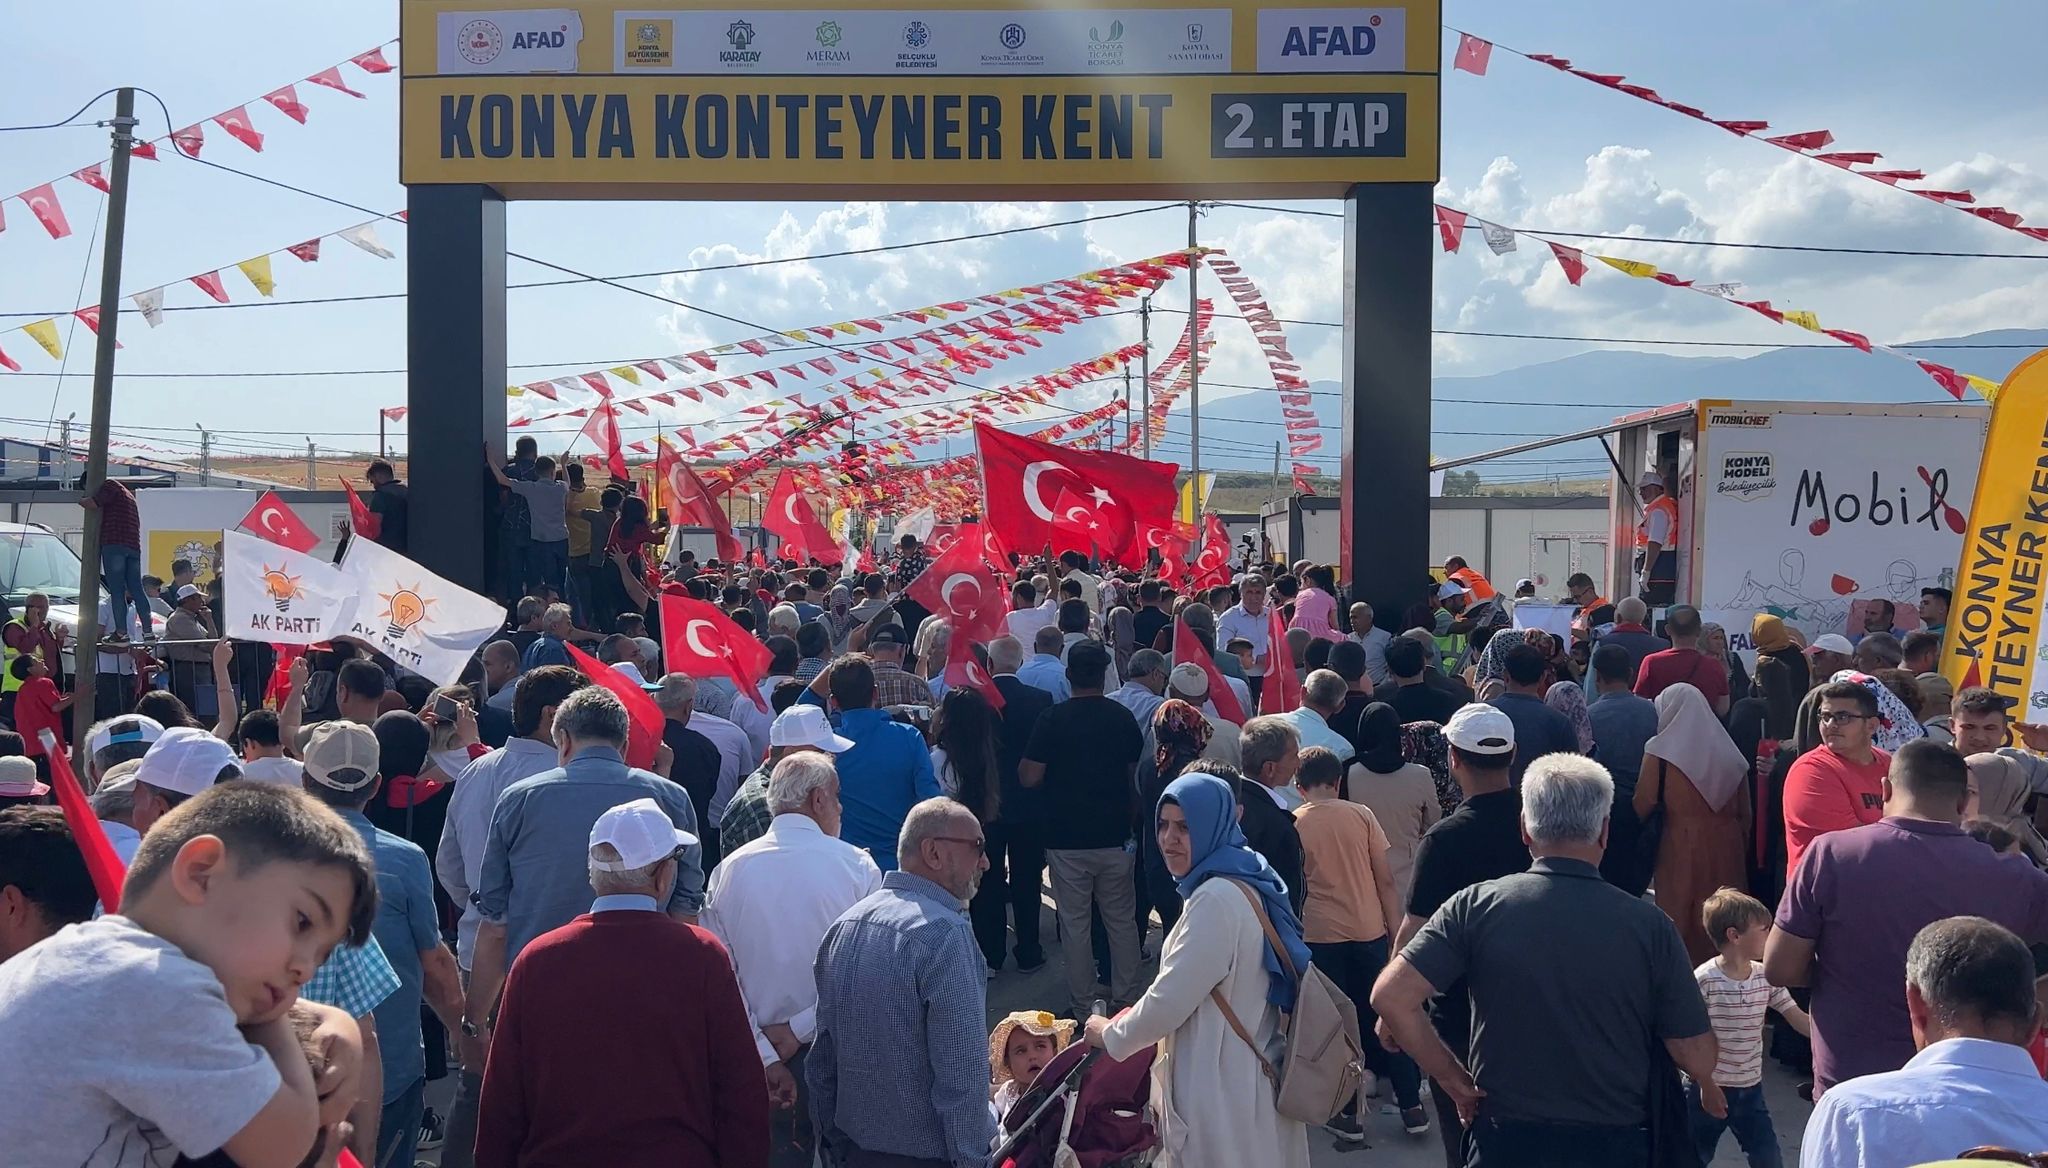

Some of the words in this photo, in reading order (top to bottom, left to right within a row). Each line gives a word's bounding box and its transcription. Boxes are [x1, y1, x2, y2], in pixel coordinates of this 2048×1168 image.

[512, 32, 565, 49] AFAD
[1281, 26, 1377, 57] AFAD
[719, 51, 762, 62] KARATAY
[806, 50, 851, 61] MERAM
[897, 53, 936, 61] SELÇUKLU
[440, 94, 635, 159] KONYA
[655, 94, 1001, 160] KONTEYNER
[1022, 94, 1173, 160] KENT
[1224, 102, 1390, 149] 2.ETAP
[1711, 415, 1770, 426] MOBILCHEF
[1725, 456, 1770, 468] KONYA
[1717, 478, 1776, 495] Belediyecilik
[1790, 467, 1948, 532] Mobil
[1955, 523, 2012, 658] KONYA
[251, 613, 271, 631] AK
